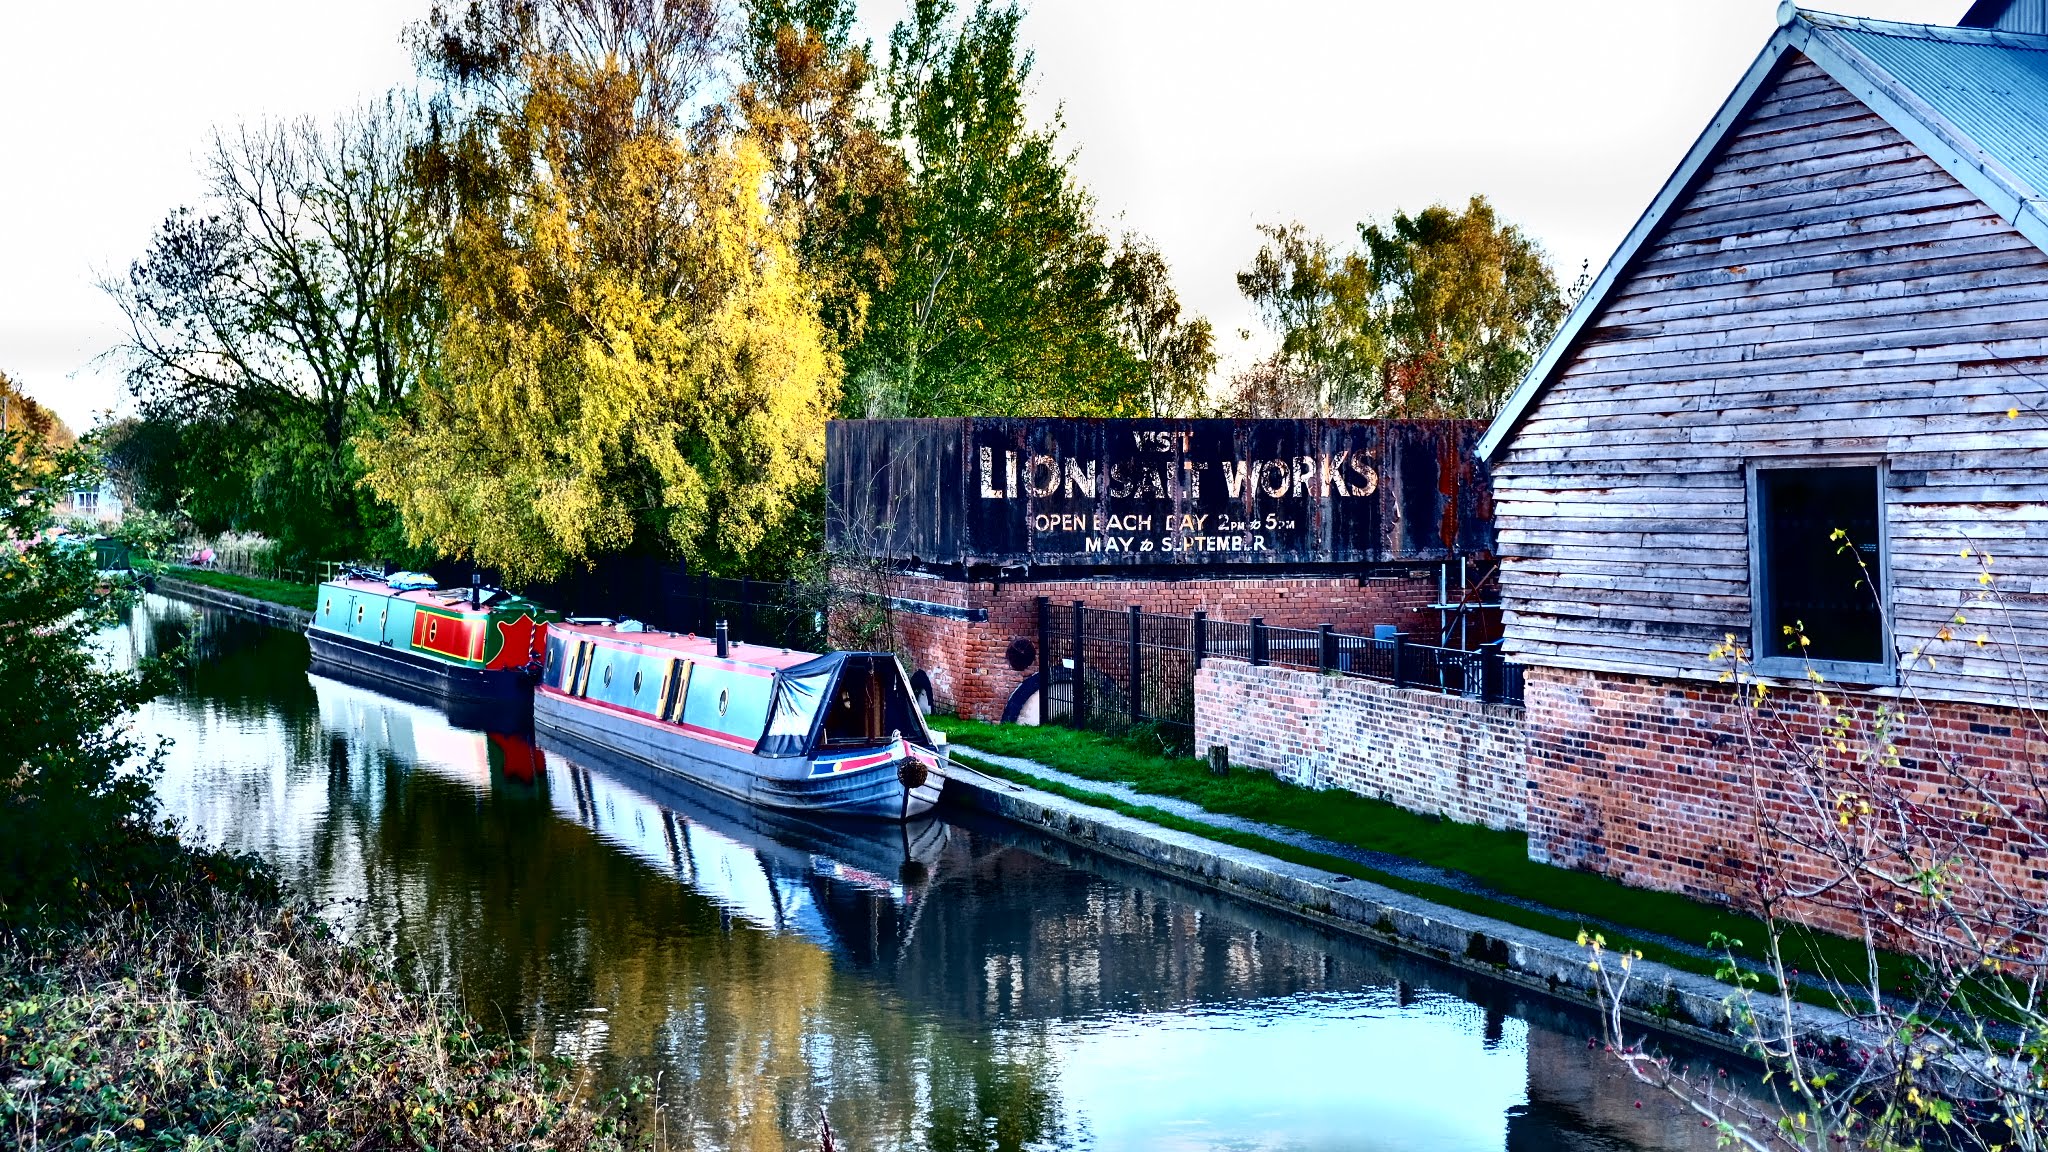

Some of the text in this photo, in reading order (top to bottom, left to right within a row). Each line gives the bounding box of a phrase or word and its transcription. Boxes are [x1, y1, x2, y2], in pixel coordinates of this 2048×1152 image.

[980, 446, 1096, 499] LION
[1222, 449, 1379, 499] WORKS
[1035, 514, 1086, 531] OPEN
[1093, 514, 1152, 531] EACH
[1165, 514, 1209, 531] DAY
[1085, 536, 1135, 552] MAY
[1140, 538, 1154, 552] to
